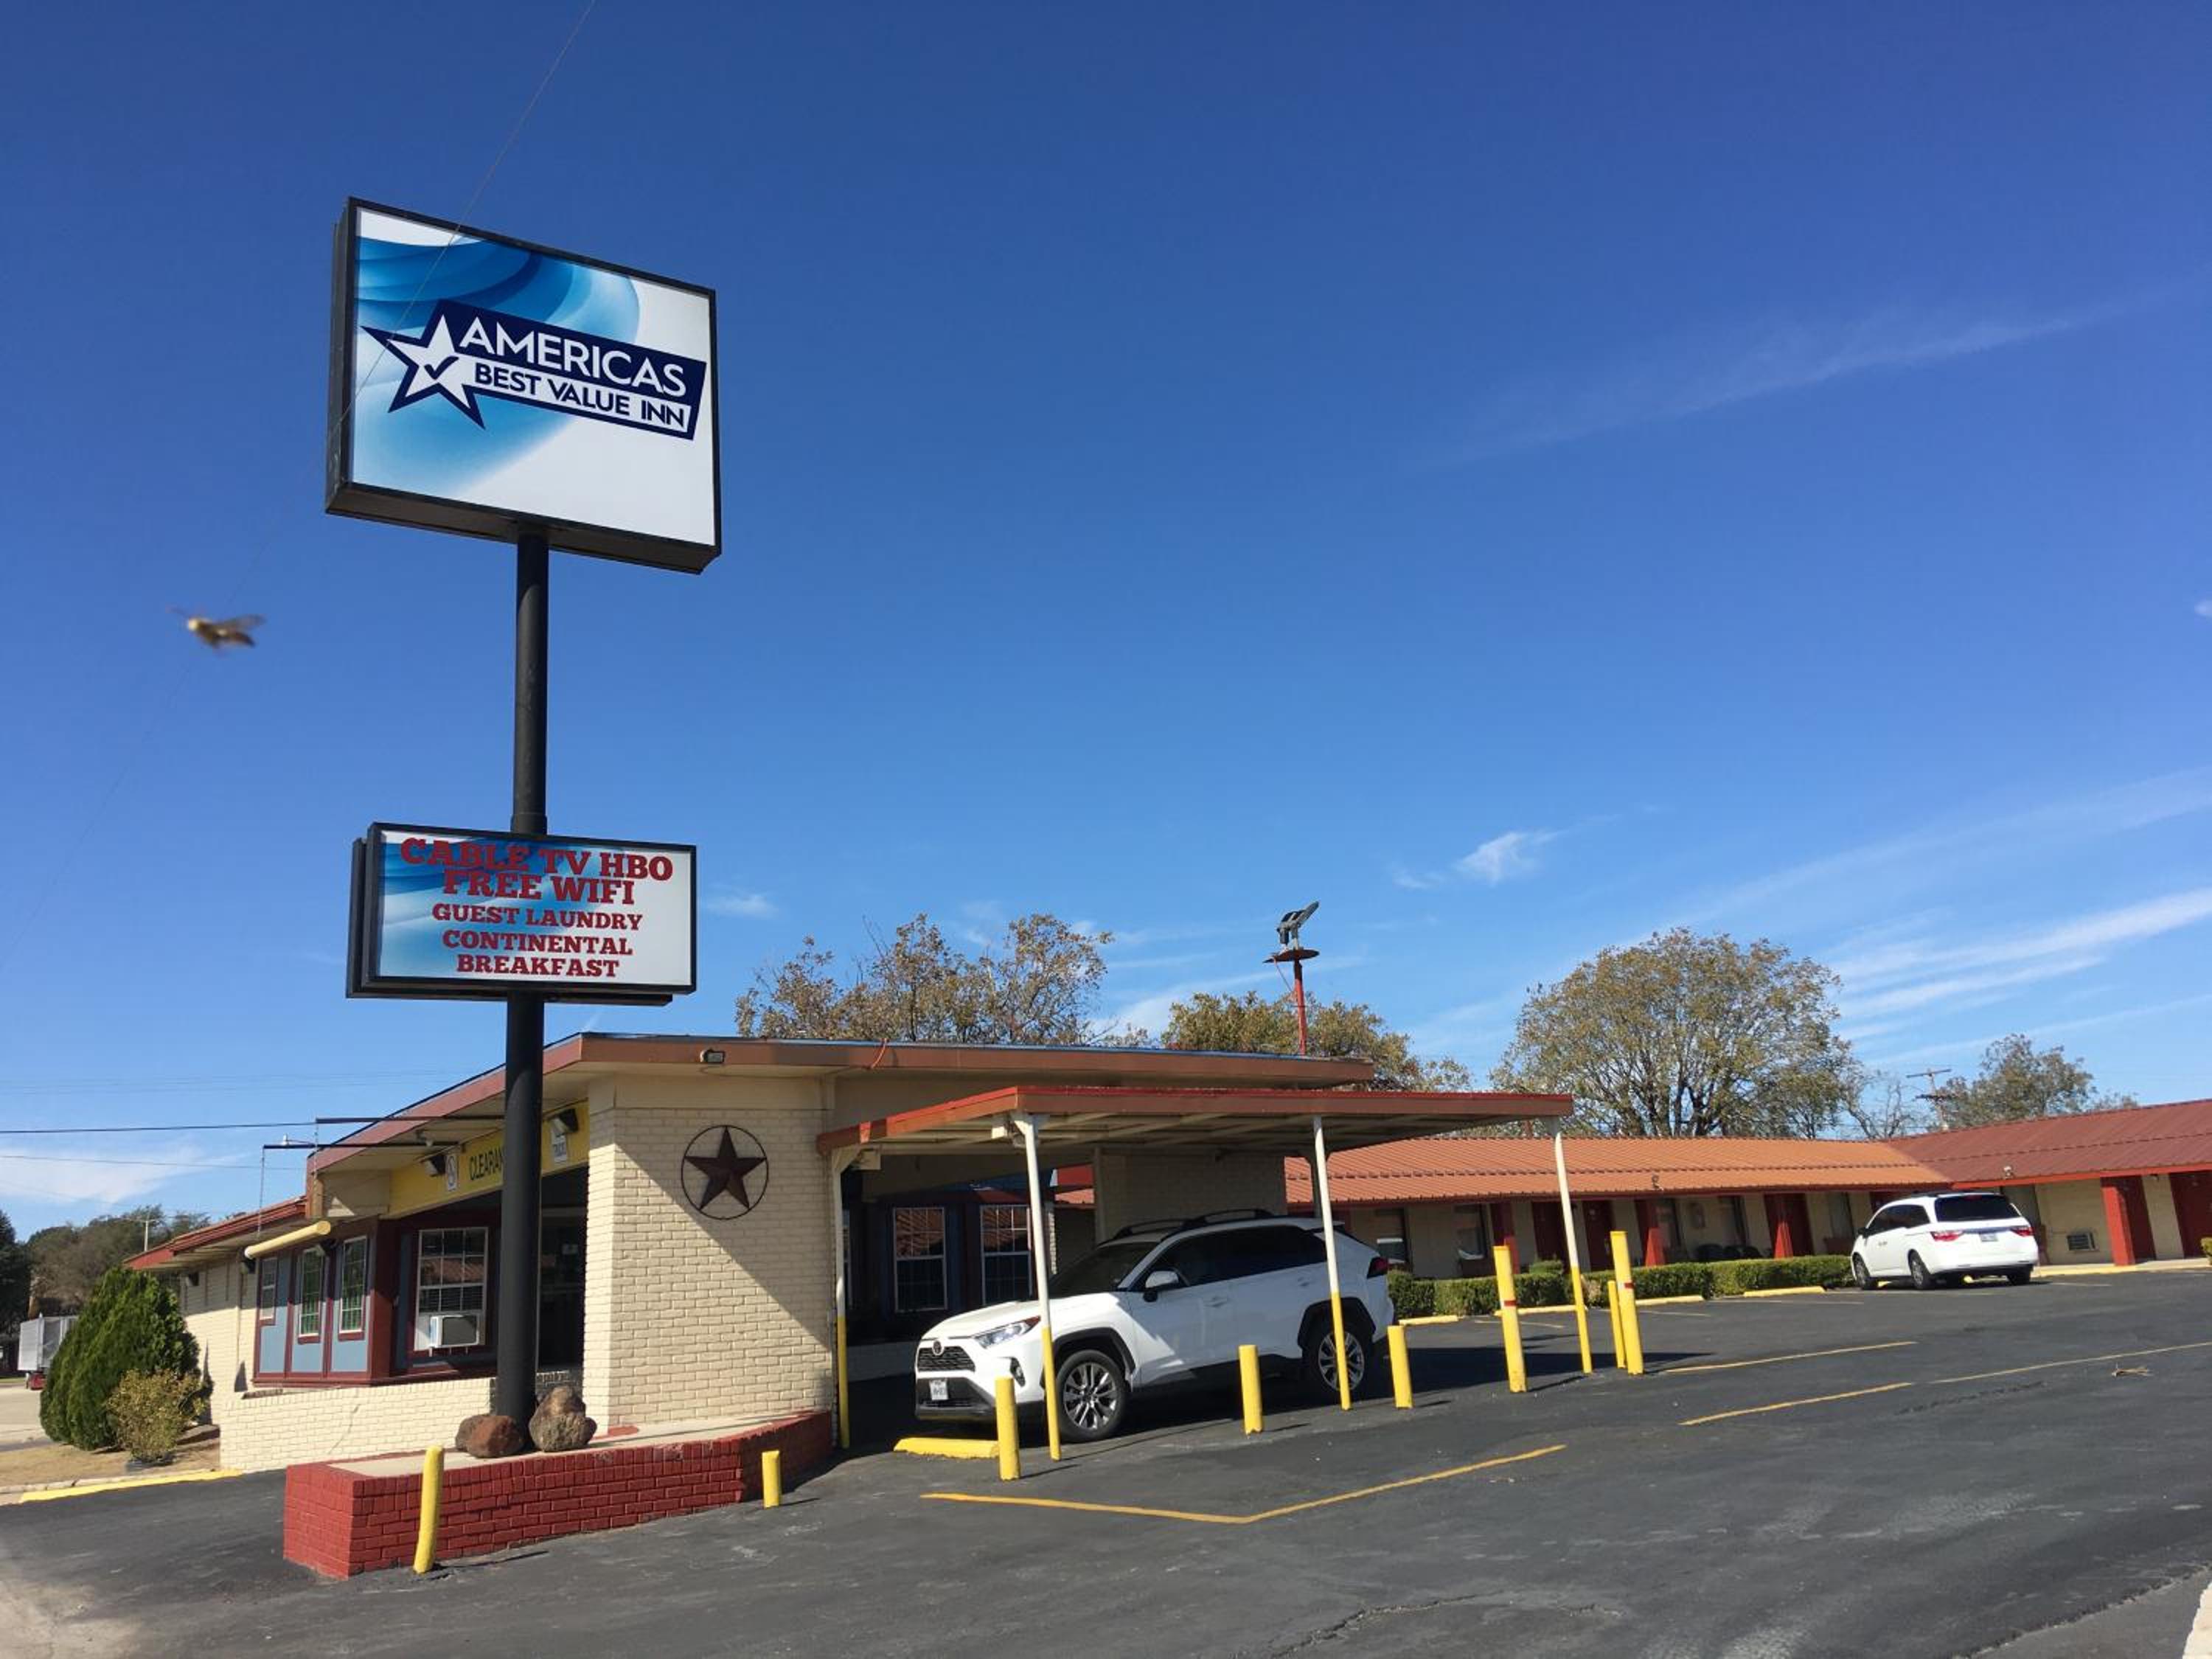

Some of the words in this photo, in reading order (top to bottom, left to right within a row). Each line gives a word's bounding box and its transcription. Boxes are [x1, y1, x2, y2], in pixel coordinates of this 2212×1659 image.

[459, 316, 686, 396] AMERICAS
[475, 363, 541, 395] BEST
[547, 378, 630, 416] VALUE
[641, 403, 684, 428] INN
[400, 838, 529, 871] CABLE
[540, 849, 591, 875] TV
[599, 852, 673, 880] HBO
[443, 870, 541, 900] FREE
[551, 877, 635, 905] WIFI
[433, 903, 519, 924] GUEST
[527, 911, 643, 931] LAUNDRY
[443, 931, 633, 955] CONTINENTAL
[457, 955, 619, 977] BREAKFAST
